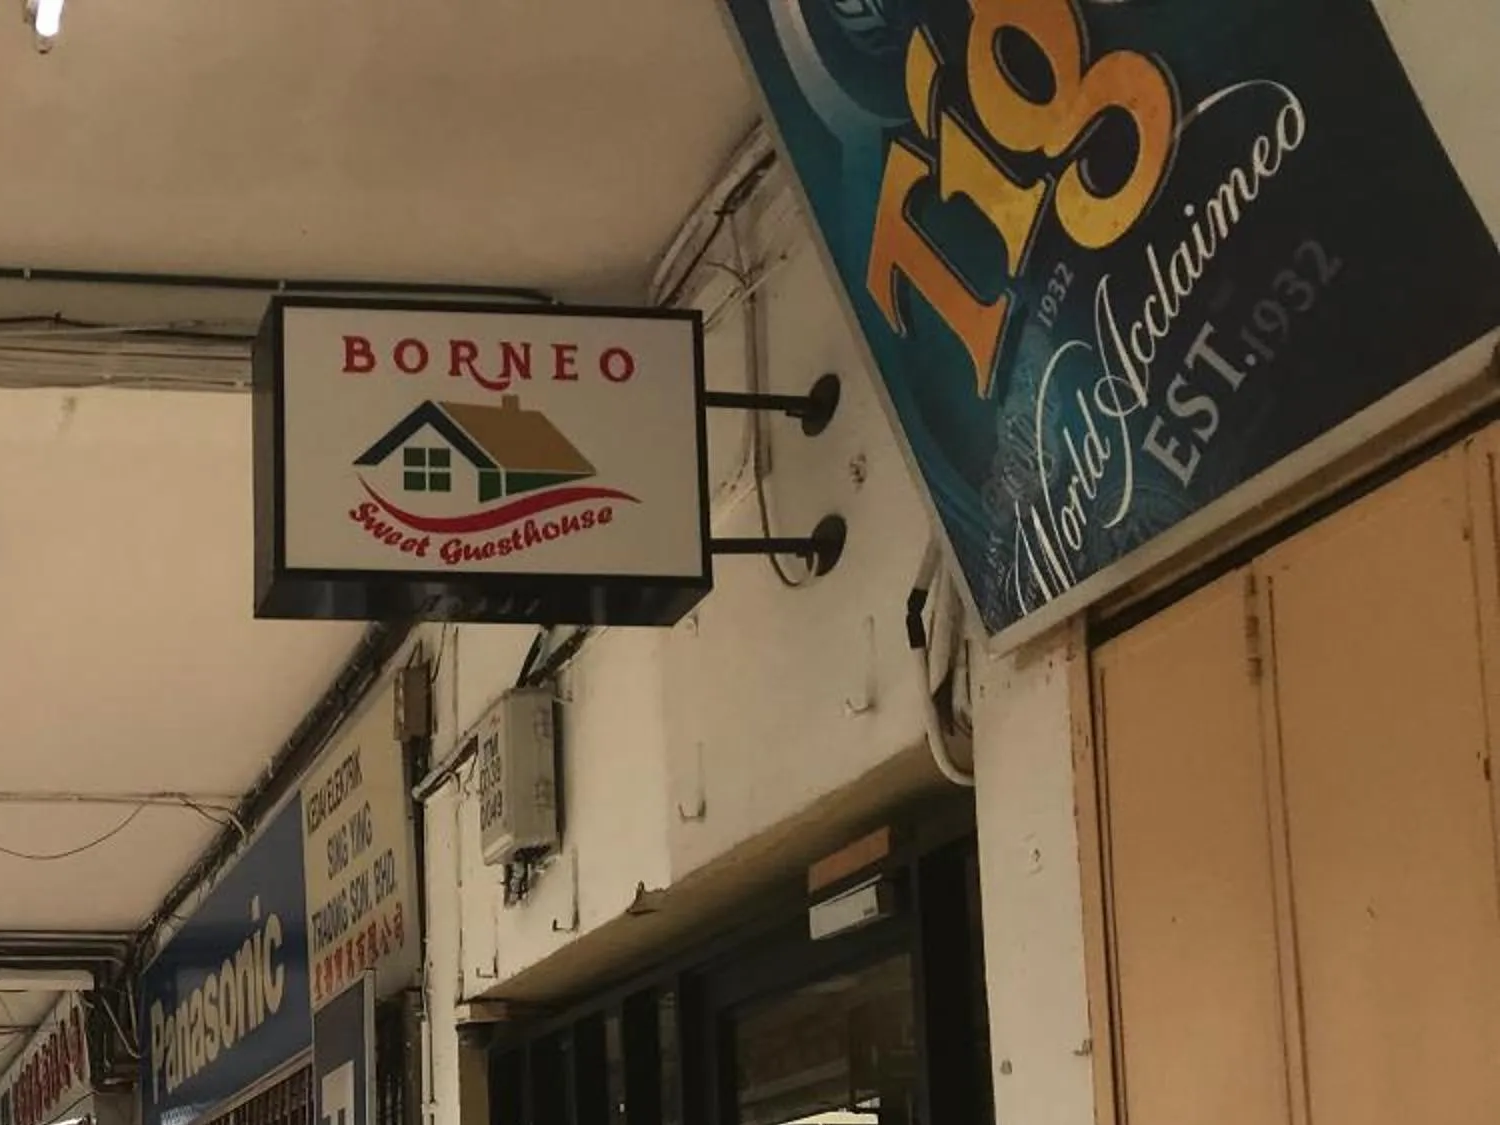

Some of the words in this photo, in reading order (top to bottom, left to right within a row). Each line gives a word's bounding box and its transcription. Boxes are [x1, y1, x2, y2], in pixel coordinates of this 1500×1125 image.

[341, 334, 635, 391] BORNEO
[1011, 338, 1112, 616] World
[1094, 79, 1308, 529] Acclaimed
[348, 502, 431, 558] Sweet
[439, 506, 614, 566] Guesthouse
[150, 895, 285, 1105] Panasonic
